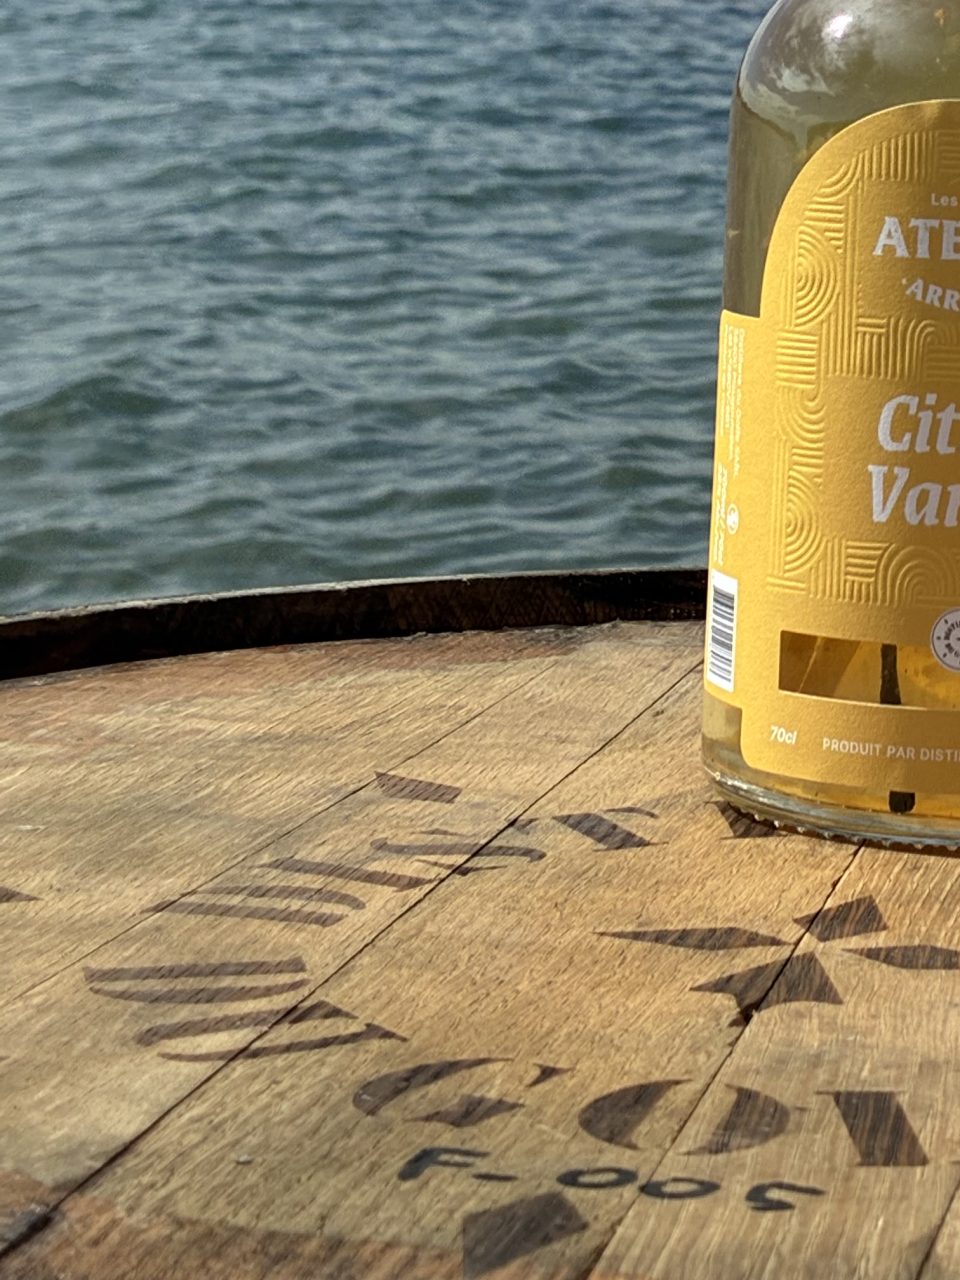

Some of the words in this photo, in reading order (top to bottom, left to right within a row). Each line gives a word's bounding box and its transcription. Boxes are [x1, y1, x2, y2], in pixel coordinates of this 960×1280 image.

[930, 193, 958, 207] Les
[770, 725, 797, 746] 70cl
[822, 737, 882, 757] PRODUIT
[886, 741, 916, 760] PAR
